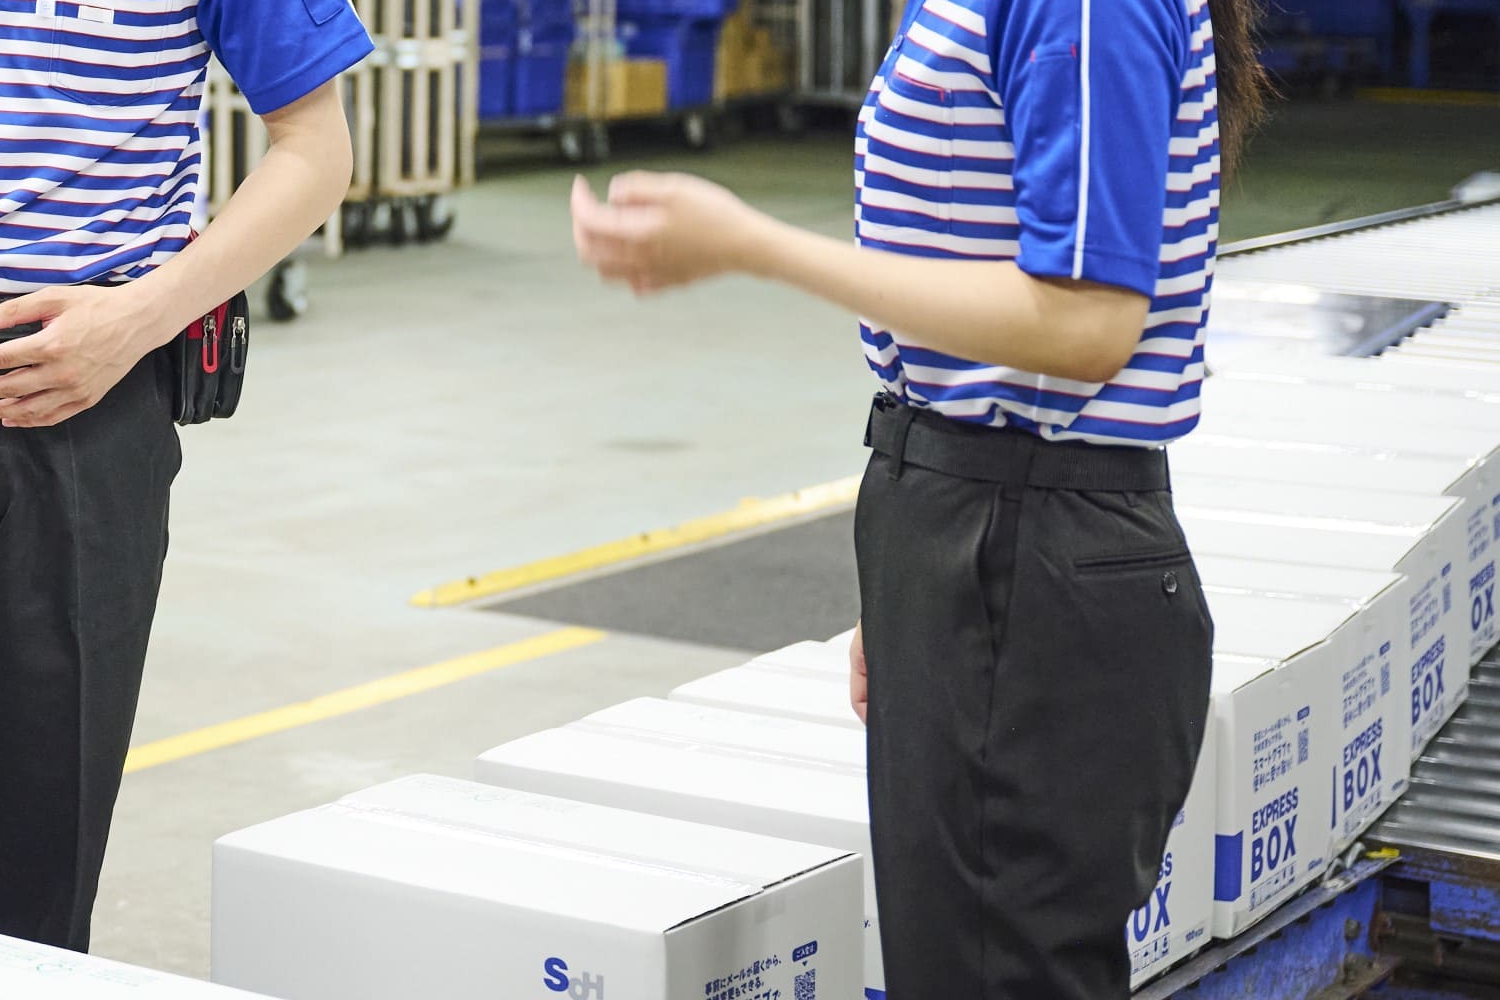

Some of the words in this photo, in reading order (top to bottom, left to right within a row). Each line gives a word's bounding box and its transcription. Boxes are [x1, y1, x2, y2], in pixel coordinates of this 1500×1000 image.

[1471, 582, 1494, 631] OX
[1411, 633, 1444, 685] EXPRESS
[1411, 657, 1444, 727] BOX
[1344, 717, 1382, 768] EXPRESS
[1344, 742, 1382, 812] BOX
[1252, 786, 1298, 835] EXPRESS
[1251, 814, 1297, 883] BOX
[1125, 881, 1172, 945] OX
